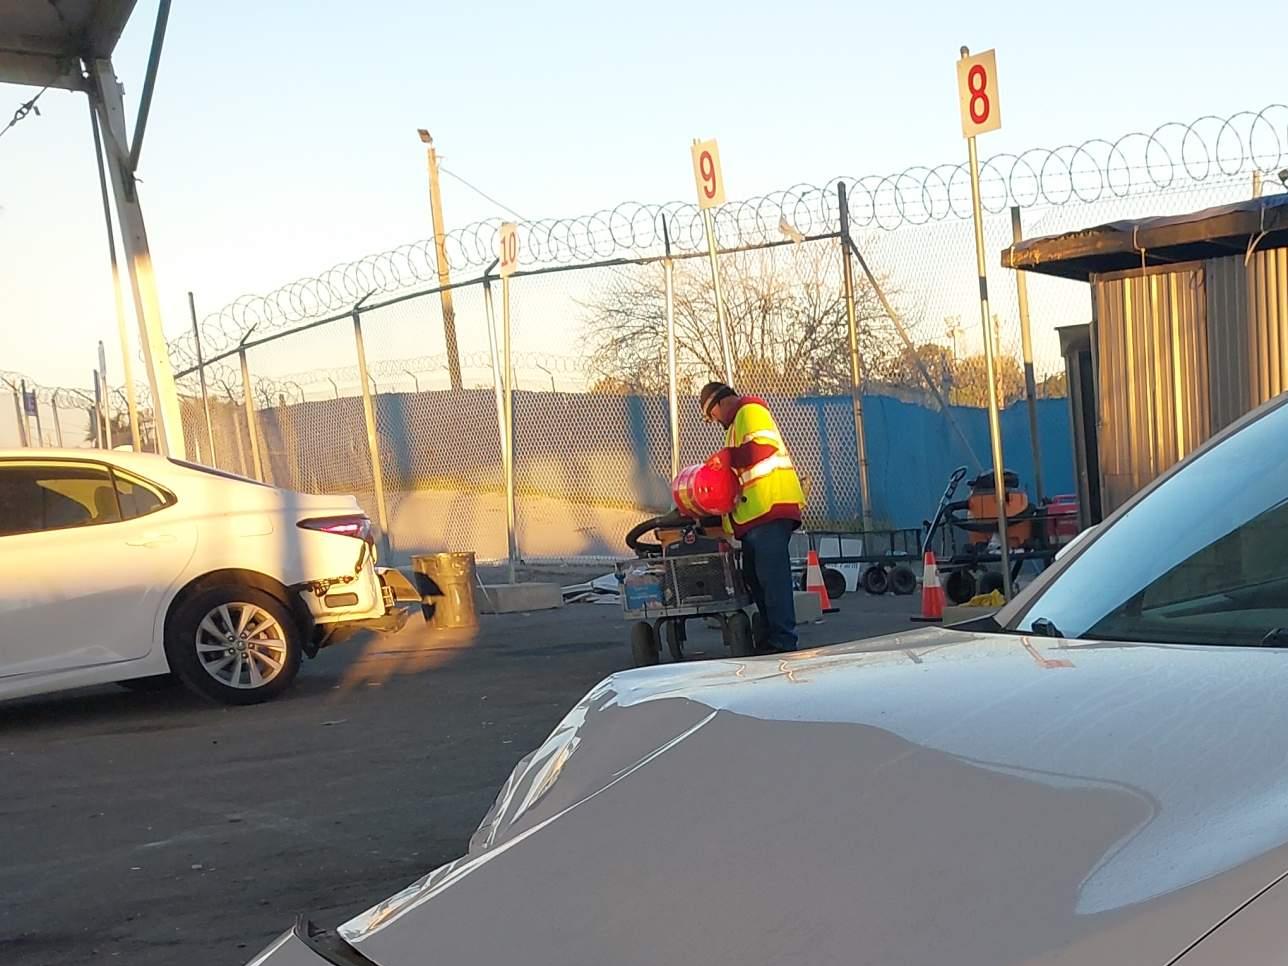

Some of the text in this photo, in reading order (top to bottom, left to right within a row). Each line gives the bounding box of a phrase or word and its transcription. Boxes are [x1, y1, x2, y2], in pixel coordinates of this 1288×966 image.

[967, 64, 990, 124] 8
[699, 150, 717, 199] 9
[501, 231, 517, 267] 10
